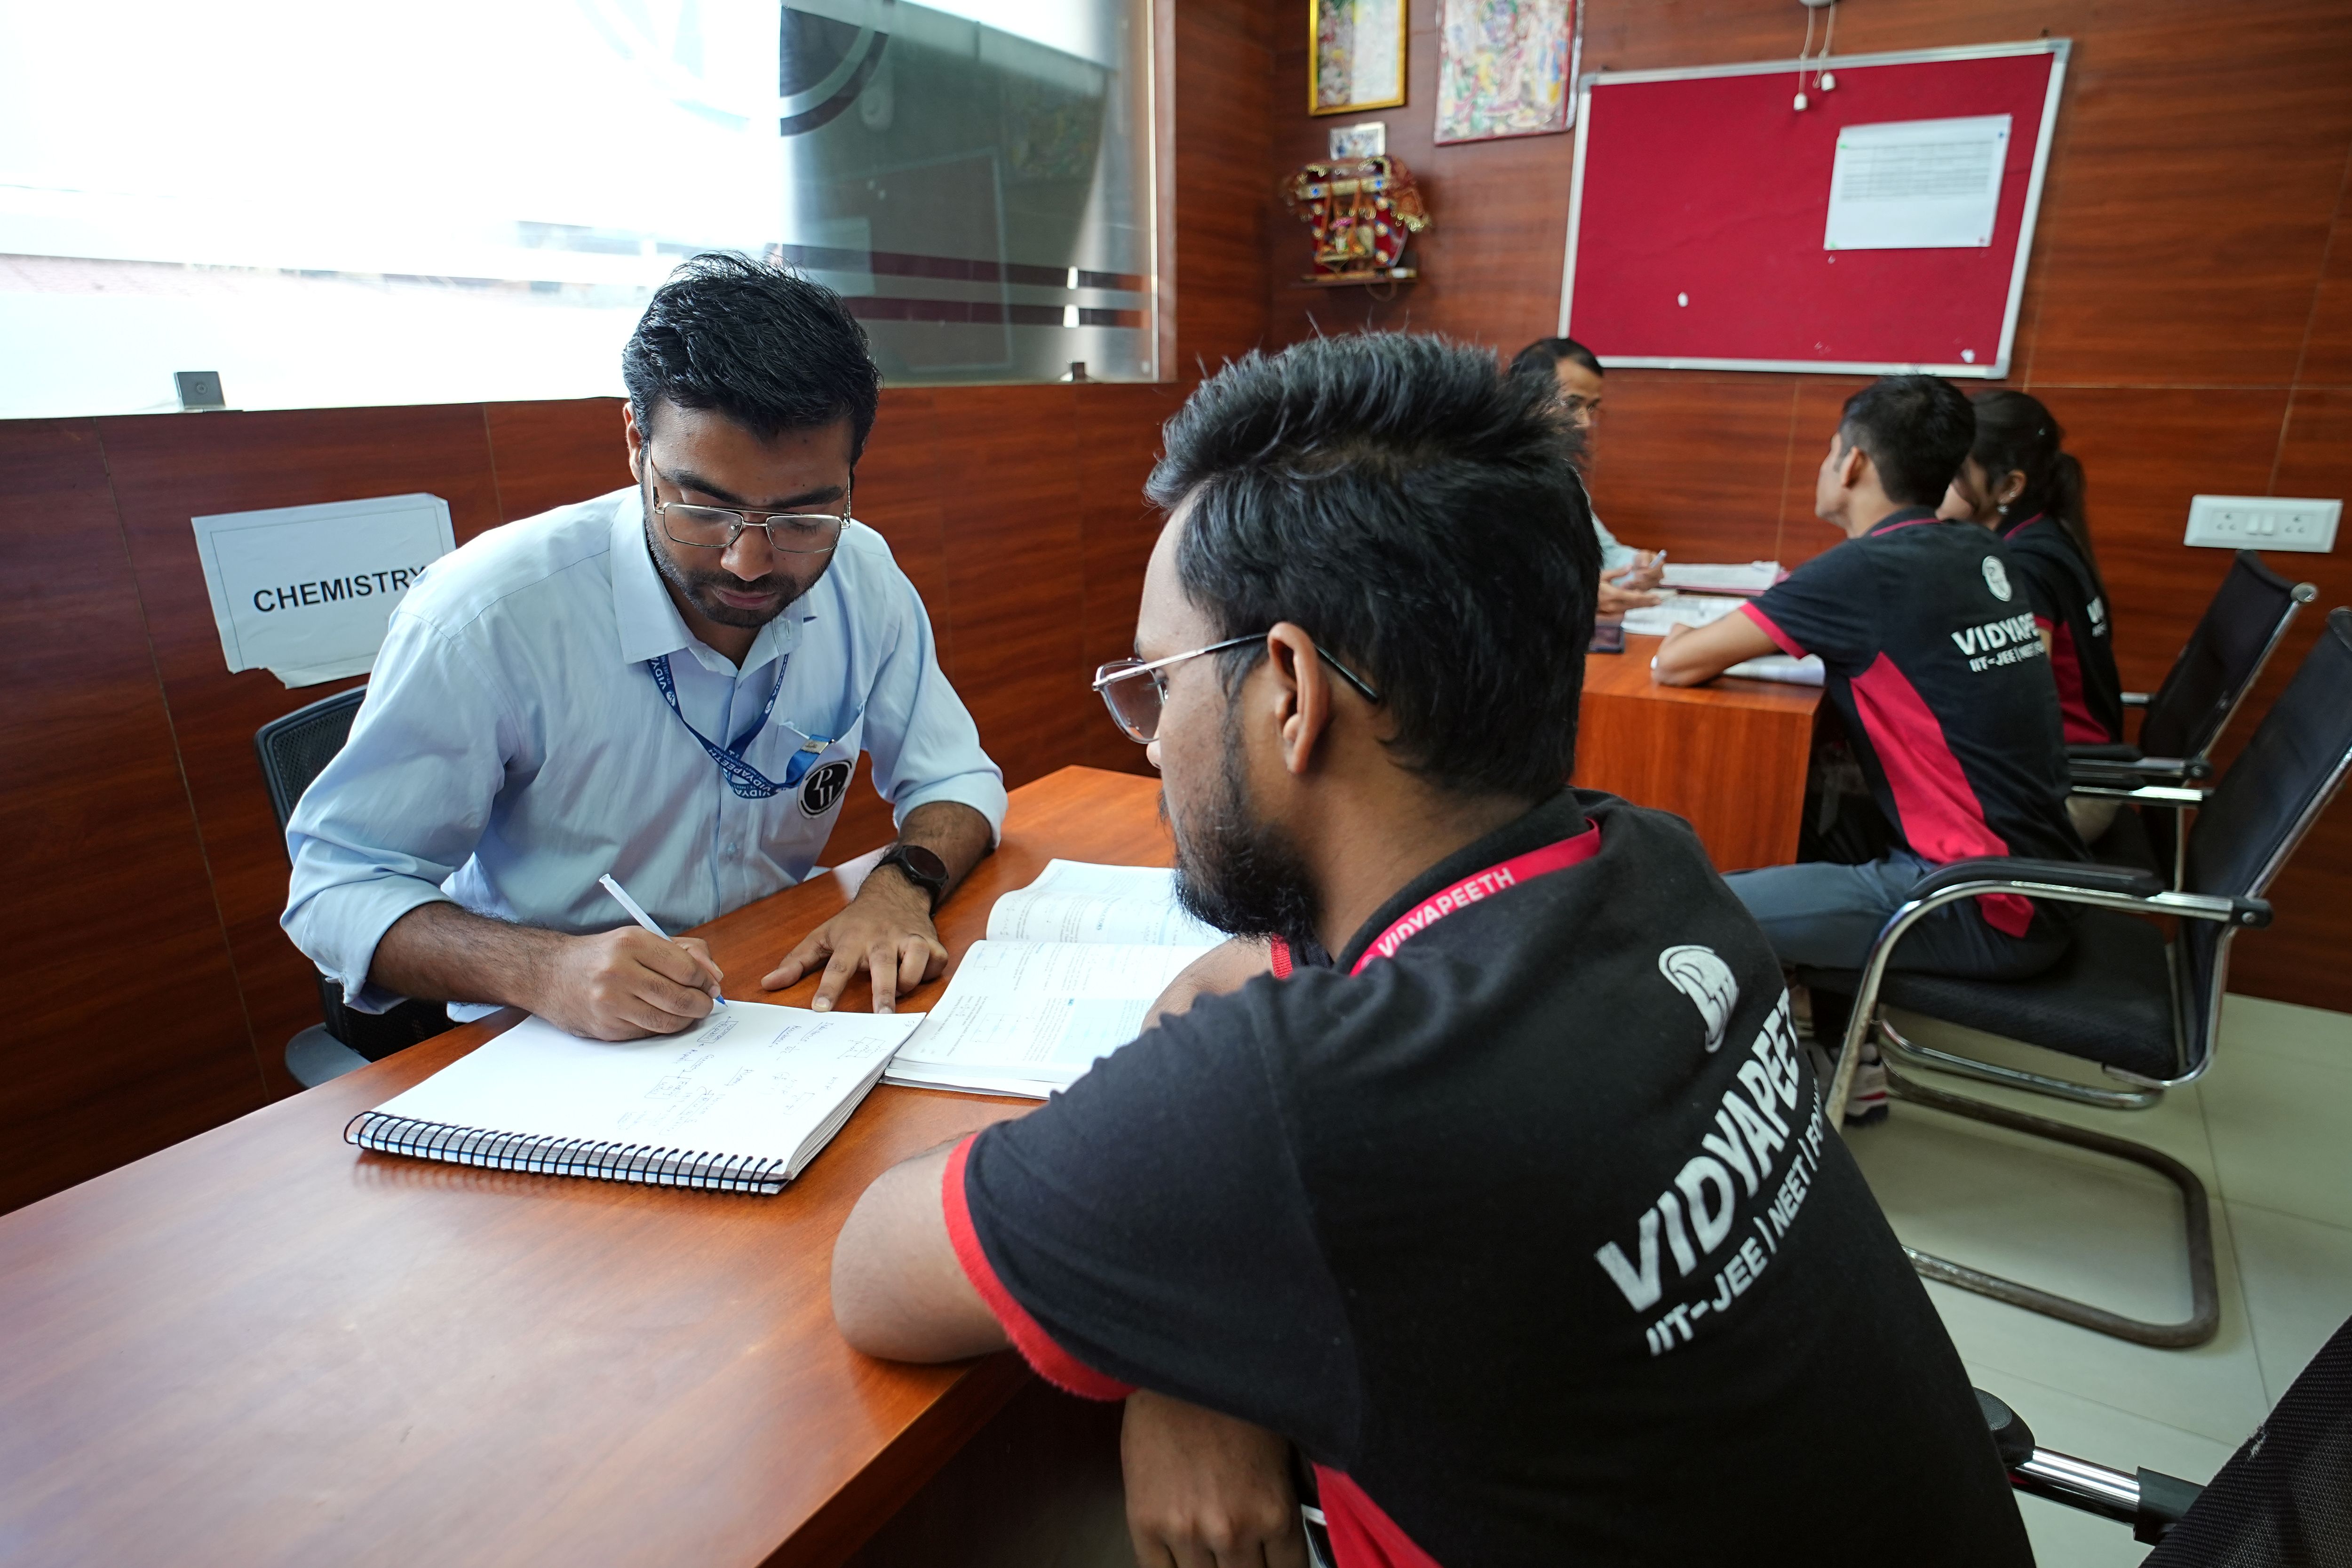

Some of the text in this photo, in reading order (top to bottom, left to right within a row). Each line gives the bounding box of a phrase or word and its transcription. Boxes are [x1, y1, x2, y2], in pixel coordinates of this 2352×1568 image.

[708, 749, 771, 792] VIDYAPEETH
[713, 747, 743, 768] FOUNDATION
[1377, 867, 1516, 958] VIDYAPEETH
[1646, 1236, 1769, 1356] IIT-JEE
[1767, 1154, 1811, 1239] NEET
